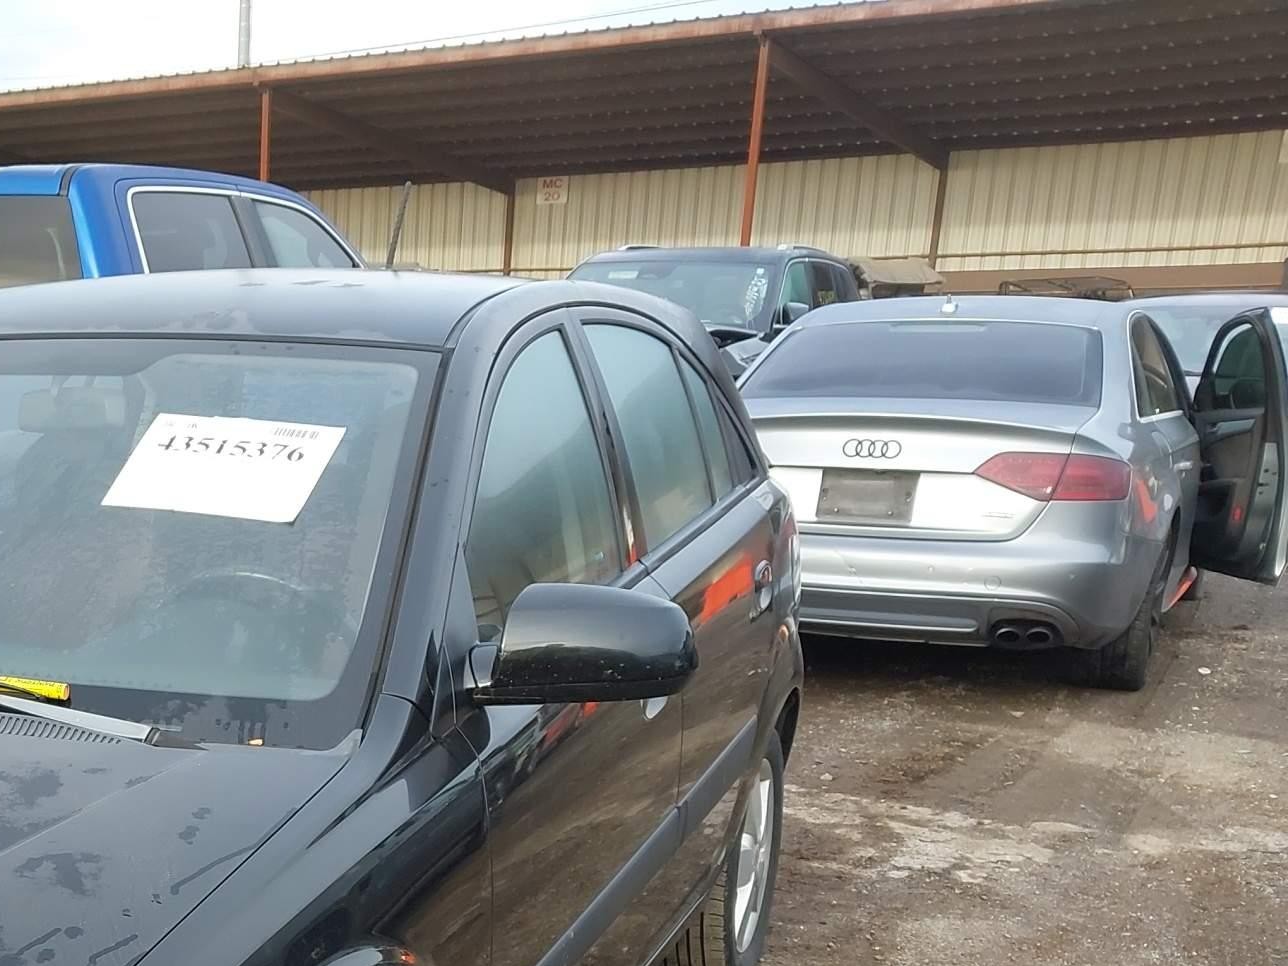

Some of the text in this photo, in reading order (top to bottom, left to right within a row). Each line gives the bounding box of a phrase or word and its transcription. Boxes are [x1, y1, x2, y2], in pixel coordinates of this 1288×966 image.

[542, 178, 562, 189] MC
[544, 191, 560, 202] 20
[157, 434, 305, 462] 43515376
